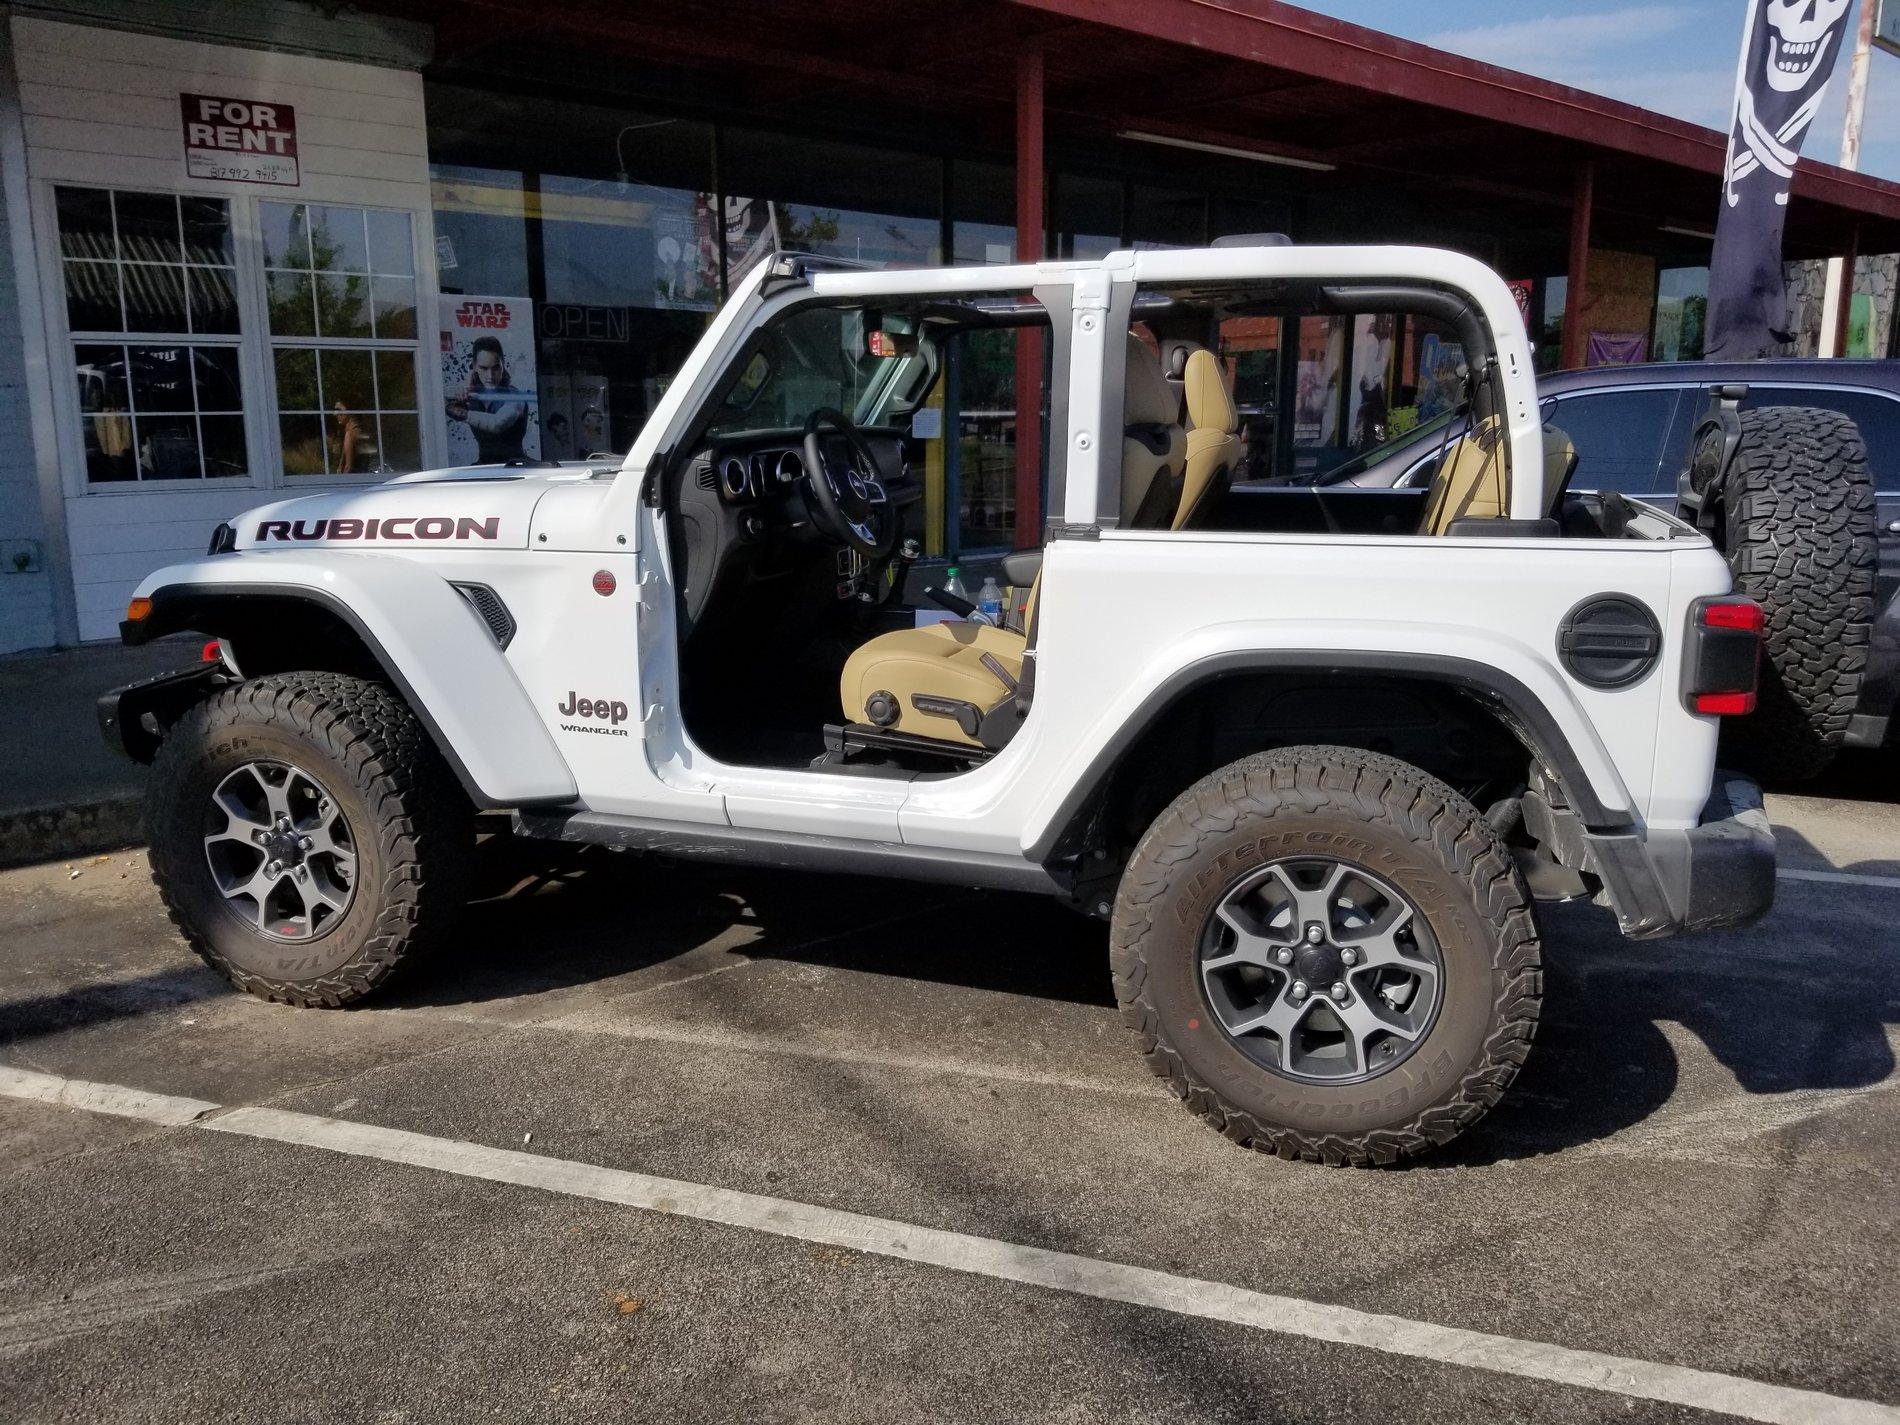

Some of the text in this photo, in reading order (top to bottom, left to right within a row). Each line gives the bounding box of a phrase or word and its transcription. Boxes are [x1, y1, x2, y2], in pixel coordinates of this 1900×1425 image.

[200, 99, 277, 129] FOR
[188, 123, 292, 154] RENT
[228, 168, 250, 179] 992
[455, 302, 511, 316] STAR
[456, 315, 511, 329] WARS
[542, 306, 626, 338] OPEN
[255, 517, 500, 541] RUBICON
[558, 691, 628, 725] Jeep
[560, 724, 629, 736] WRANGLER
